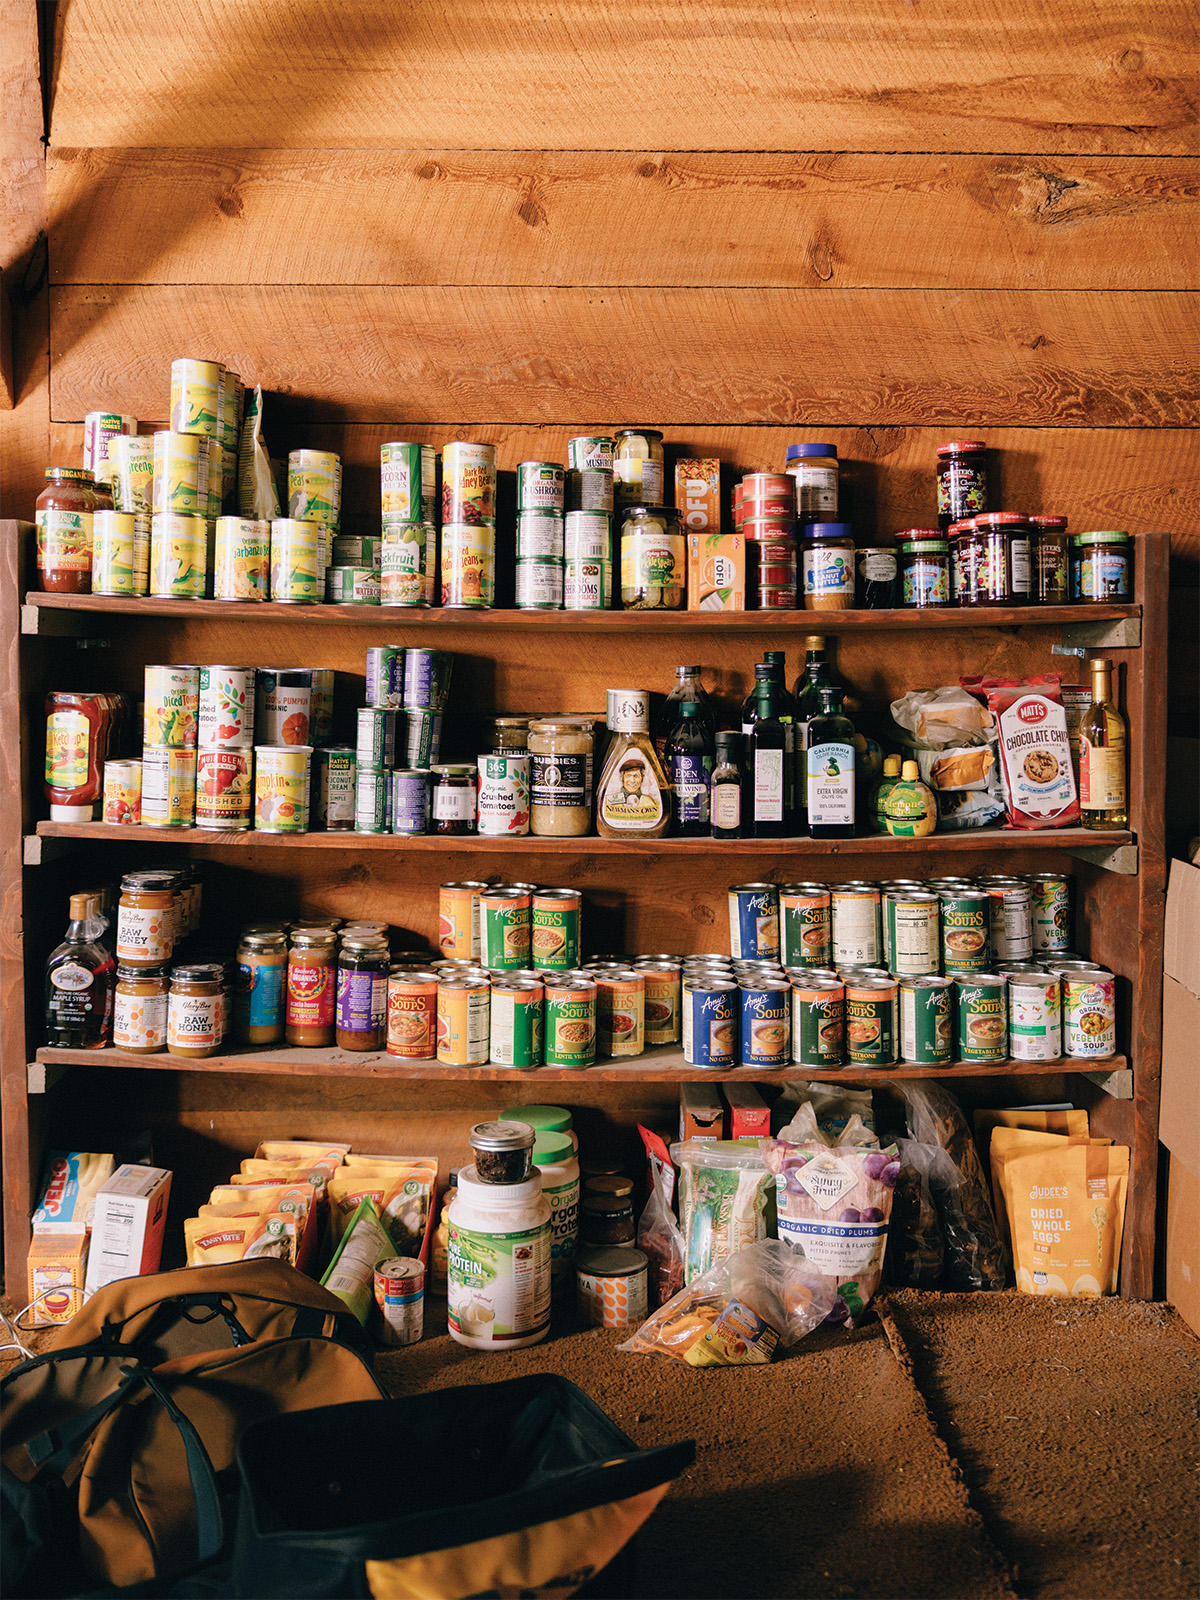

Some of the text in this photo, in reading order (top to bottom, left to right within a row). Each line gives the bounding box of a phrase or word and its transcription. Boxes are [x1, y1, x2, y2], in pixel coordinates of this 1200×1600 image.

[60, 470, 88, 479] ORGANIC
[464, 465, 488, 477] Dark Red
[290, 475, 305, 488] Peas
[232, 545, 263, 559] Garbanzo
[715, 559, 724, 586] TOFU
[163, 695, 182, 708] Diced
[265, 695, 308, 706] 100% PUMPKIN
[264, 704, 288, 712] ORGANIC
[628, 704, 638, 714] N
[1020, 703, 1044, 719] MATT'S
[1006, 729, 1068, 751] CHOCOLATE CHIP
[813, 746, 850, 755] CALIFORNIA
[201, 754, 243, 766] MUIR GLEN
[533, 757, 577, 765] BUBBIES
[487, 762, 505, 772] 365
[675, 768, 698, 778] EDEN
[256, 771, 285, 791] umpkin
[325, 776, 351, 784] COCONUT
[198, 797, 243, 805] CRUSHED
[481, 792, 514, 801] Crushed
[480, 801, 516, 810] Tomatoes
[606, 805, 658, 814] NEWMAN'S OWN
[888, 799, 918, 808] Lemon
[747, 892, 770, 911] Amy's
[494, 901, 518, 921] Amy's
[792, 900, 816, 919] Amy's
[946, 911, 984, 926] SOUPS
[121, 927, 142, 936] RAW
[119, 935, 148, 945] HONEY
[539, 957, 567, 965] VEGETABLE
[292, 974, 318, 982] ORGANICS
[549, 994, 572, 1011] Amy's
[744, 993, 769, 1011] Amy's
[925, 991, 950, 1009] Amy's
[959, 987, 984, 1006] Amy's
[304, 1002, 320, 1010] honey
[391, 996, 426, 1010] SOUPS
[701, 993, 728, 1014] Amy's
[809, 993, 834, 1013] Amy's
[970, 997, 1006, 1014] SOUPS
[560, 1003, 594, 1018] SOUPS
[755, 1002, 790, 1019] SOUPS
[1079, 1005, 1107, 1014] ORGANIC
[184, 1016, 209, 1024] RAW
[178, 1023, 213, 1032] HONEY
[1071, 1032, 1113, 1043] VEGETABLE
[964, 1047, 991, 1055] VEGETABLE
[310, 1175, 321, 1184] 60
[810, 1174, 843, 1190] Sunny
[812, 1184, 839, 1197] Fruit
[1029, 1185, 1069, 1200] JUDEE'S
[550, 1190, 580, 1208] Orgain
[281, 1203, 292, 1212] 60
[1030, 1207, 1063, 1219] DRIED
[123, 1217, 134, 1225] 200
[1031, 1219, 1071, 1231] WHOLE
[269, 1223, 281, 1232] 60
[780, 1220, 874, 1236] ORGANIC DRIED PLUMS
[200, 1232, 242, 1248] TASTY BITE
[1032, 1230, 1061, 1243] EGGS
[810, 1240, 844, 1249] EXQUISITE
[1041, 1245, 1049, 1253] OZ
[449, 1251, 482, 1275] PROTEIN
[717, 1320, 737, 1337] Dried
[714, 1328, 737, 1345] Mango
